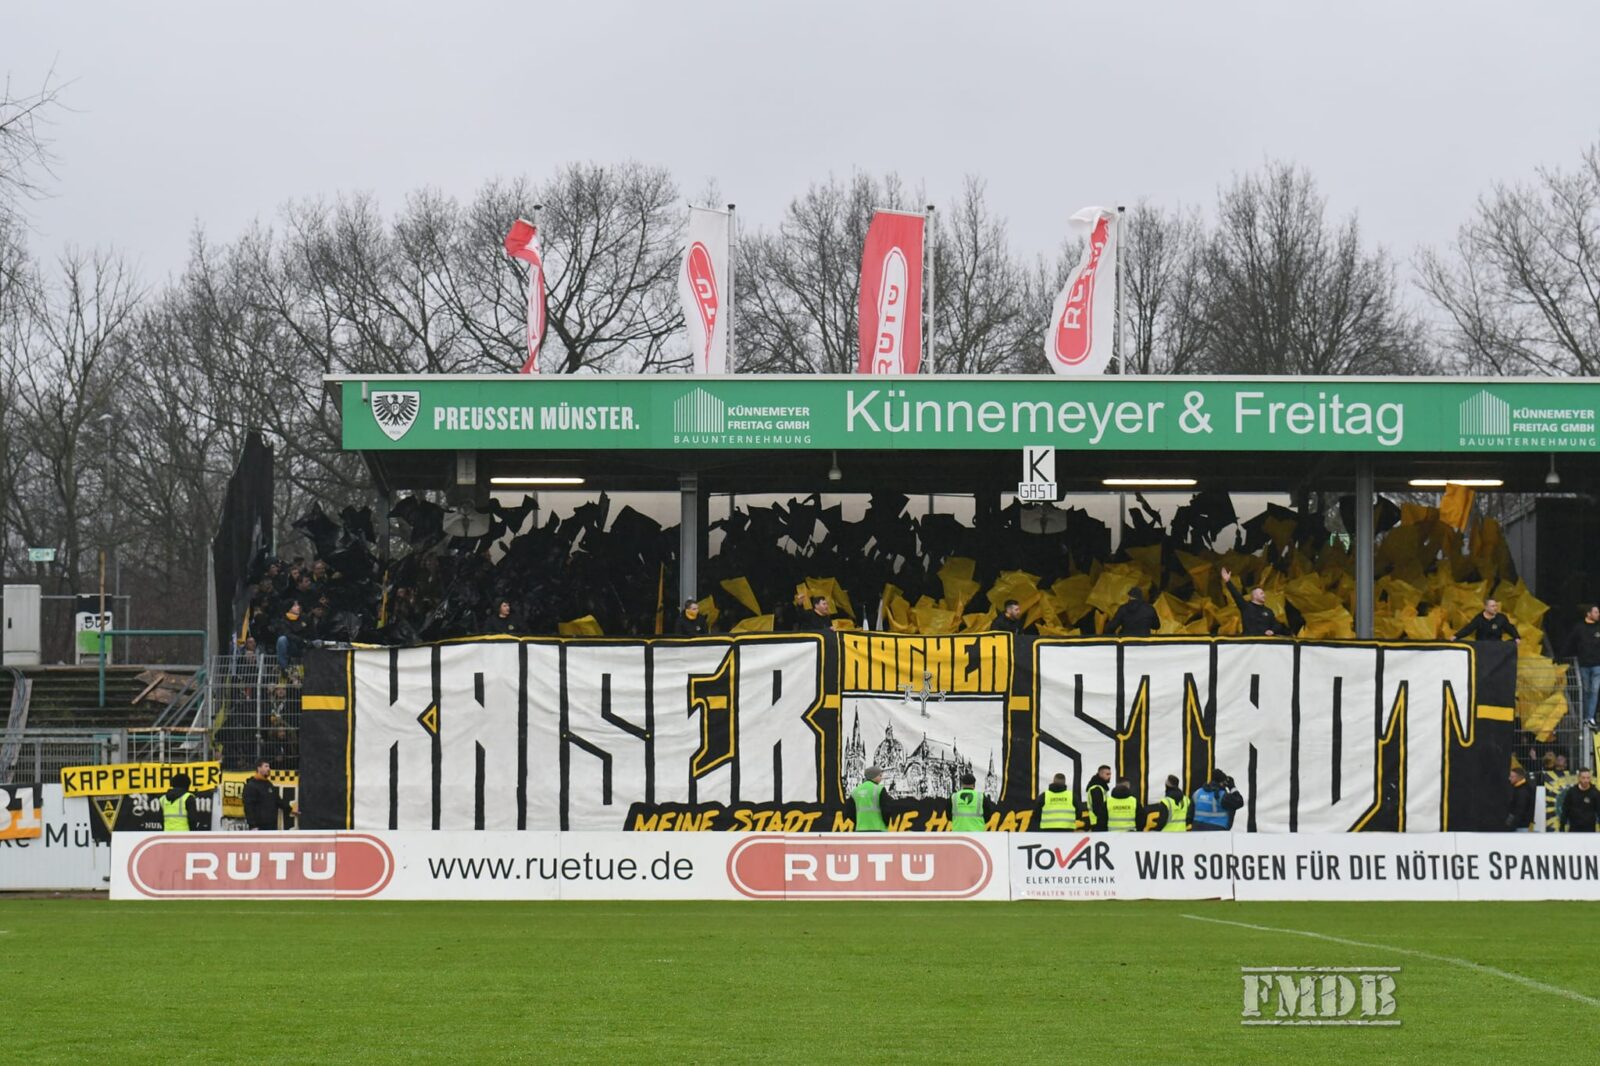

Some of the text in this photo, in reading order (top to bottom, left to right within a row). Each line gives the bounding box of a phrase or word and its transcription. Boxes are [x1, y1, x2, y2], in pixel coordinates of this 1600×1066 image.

[434, 402, 640, 430] PREUSSEN MÜNSTER.
[727, 405, 810, 417] KÜNNEMEYER
[727, 420, 810, 430] FREITAG GMBH
[846, 390, 1404, 446] Künnemeyer & Freitag
[1512, 407, 1595, 419] KÜNNEMEYER
[674, 435, 812, 444] BAUUNTERNEHMUNG
[1460, 437, 1597, 446] BAUUNTERNEHMUNG
[1512, 423, 1595, 432] FREITAG GMBH
[1030, 450, 1050, 482] K
[1020, 484, 1056, 498] GAST
[844, 634, 1009, 692] AACHEN
[352, 642, 822, 832] KAISER
[1038, 644, 1471, 832] STADT
[634, 810, 720, 831] MEINE
[727, 809, 822, 831] STADT
[184, 852, 336, 880] RÜTÜ
[428, 851, 694, 880] www.ruetue.de
[784, 853, 935, 881] RÜTÜ
[1017, 836, 1115, 871] TOVAR
[1194, 854, 1286, 880] SORGEN
[1296, 850, 1341, 881] FÜR
[1350, 854, 1387, 880] DIE
[1396, 850, 1480, 881] NÖTIGE
[1026, 876, 1116, 884] ELEKTROTECHNIK
